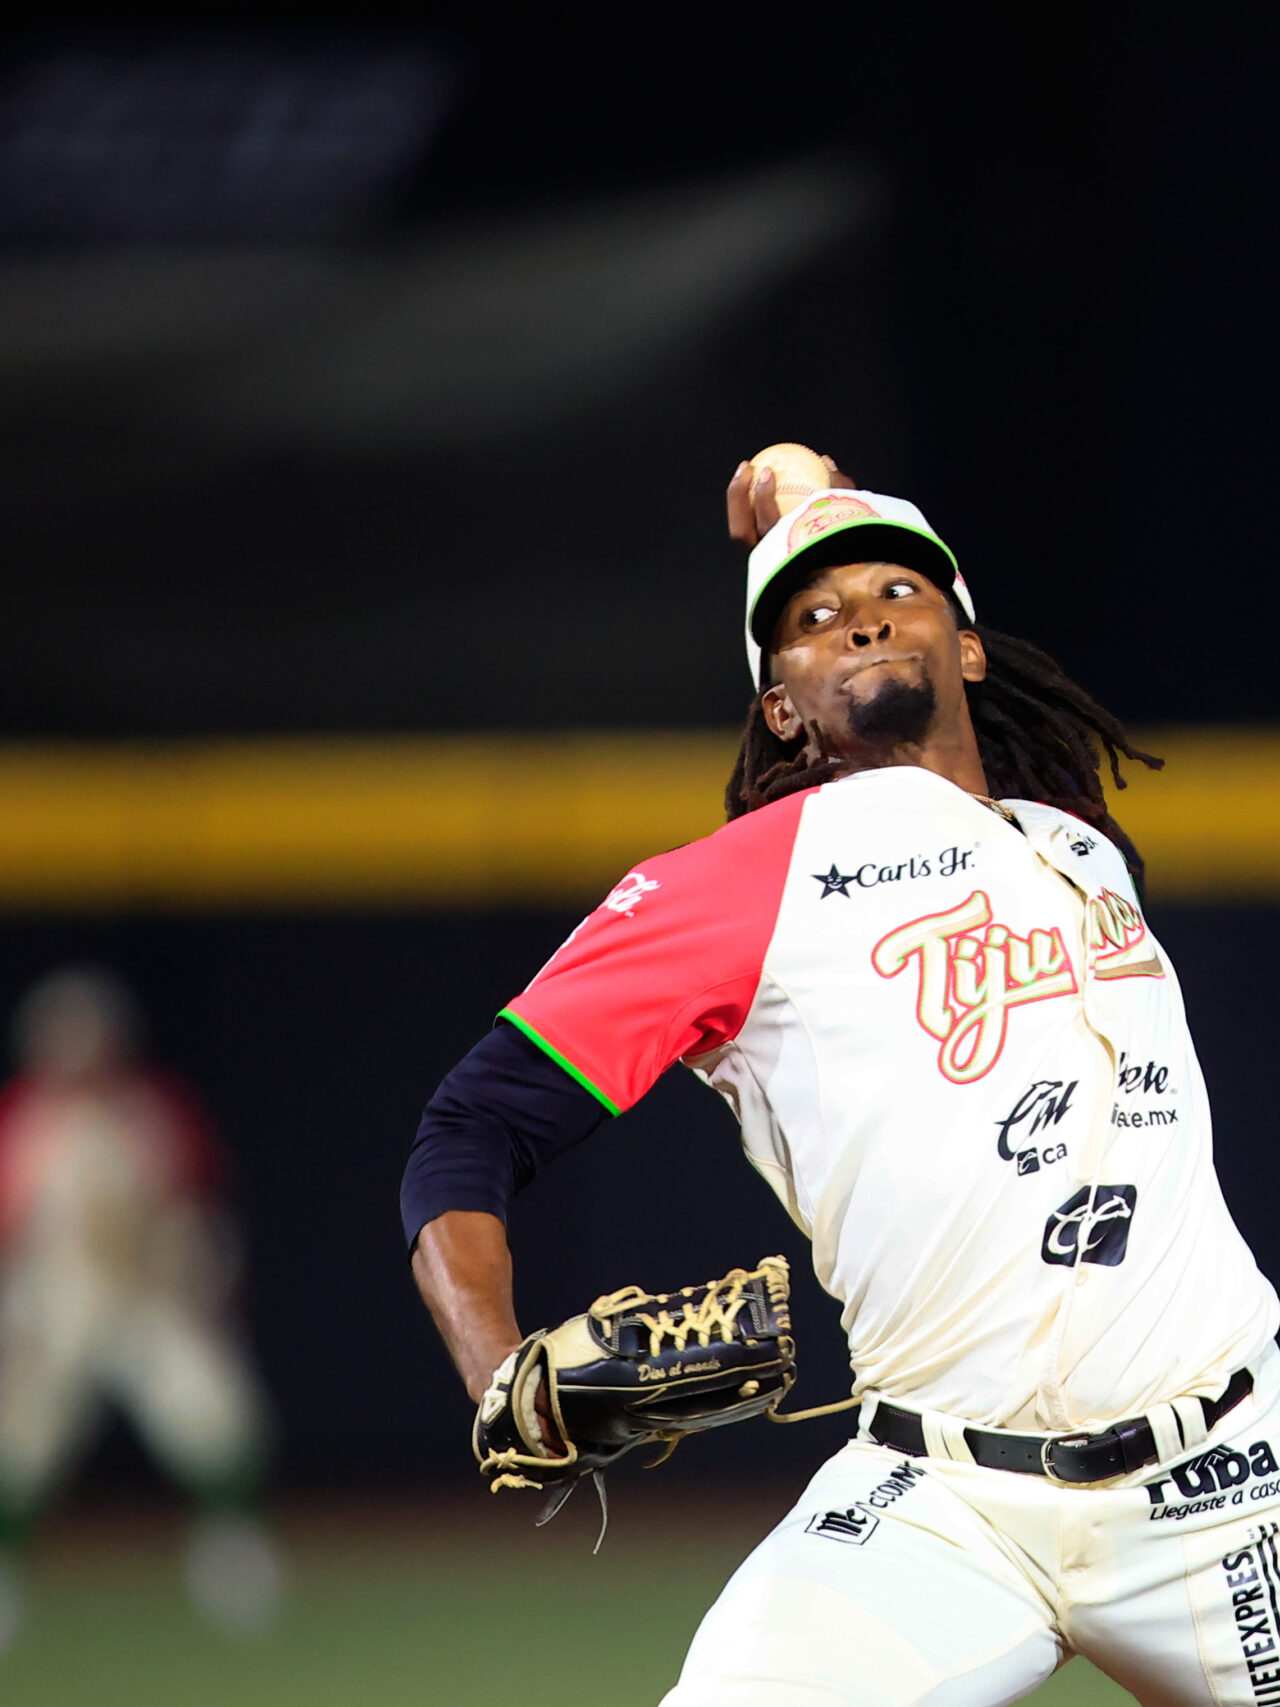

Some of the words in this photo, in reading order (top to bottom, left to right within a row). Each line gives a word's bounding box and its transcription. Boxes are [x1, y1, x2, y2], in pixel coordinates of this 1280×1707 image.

[855, 853, 932, 889] Carl's
[938, 846, 976, 877] Jr.
[1145, 1440, 1280, 1505] ruba
[1149, 1494, 1226, 1521] Llegaste
[1231, 1489, 1244, 1506] a
